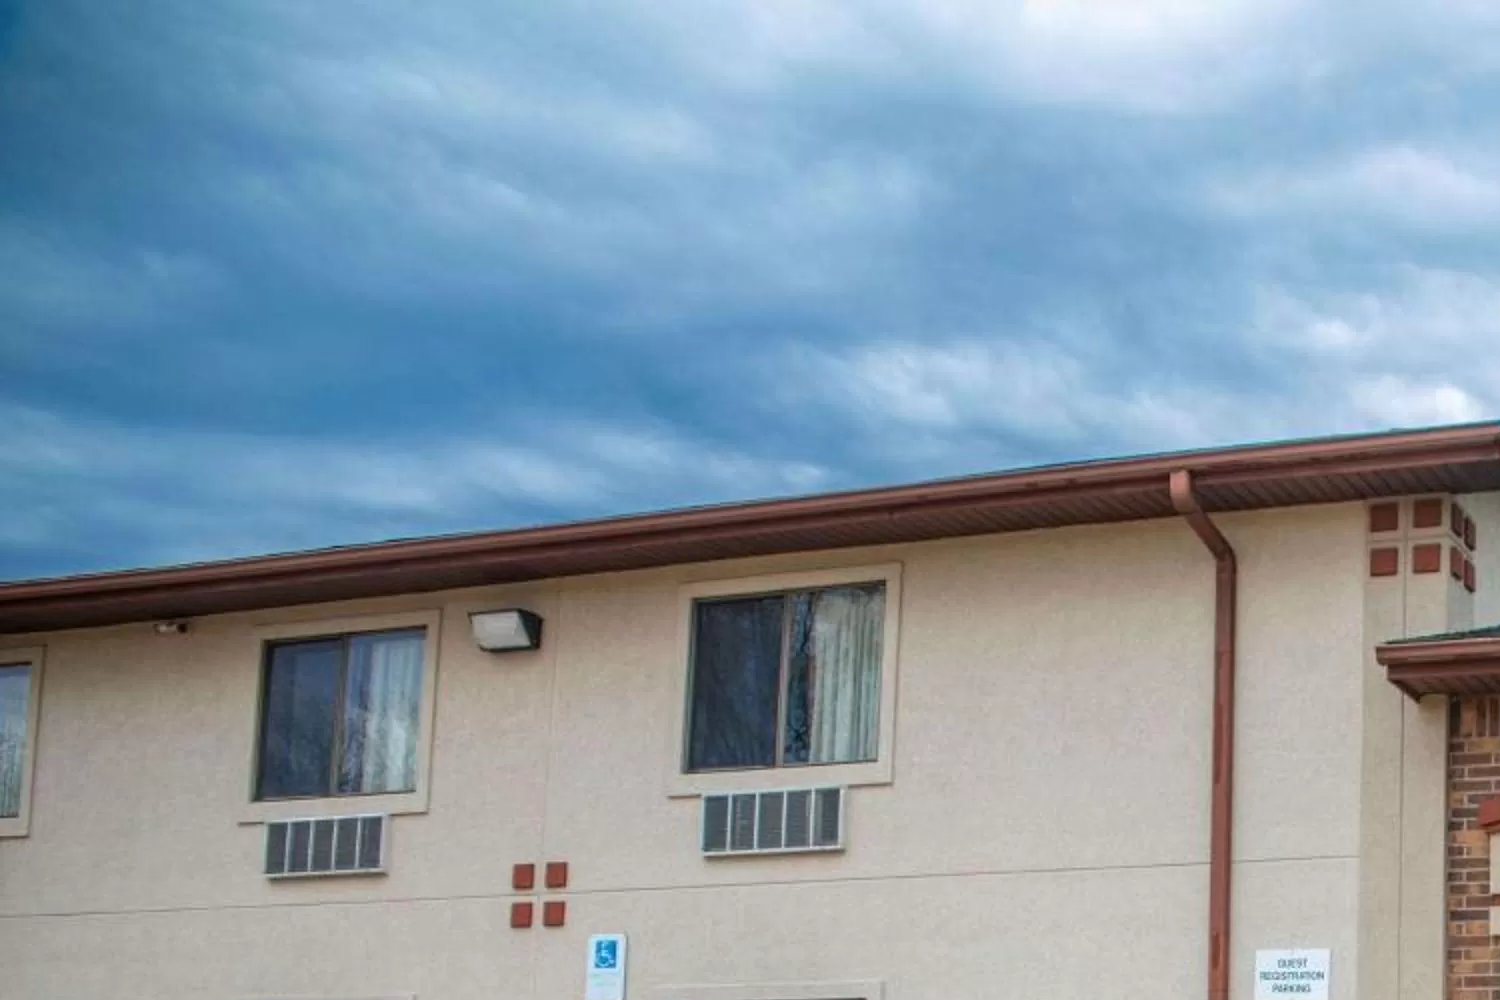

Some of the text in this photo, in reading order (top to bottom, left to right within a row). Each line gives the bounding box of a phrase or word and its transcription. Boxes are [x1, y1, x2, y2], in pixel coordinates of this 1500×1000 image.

[1277, 957, 1308, 968] GUEST
[1259, 970, 1325, 981] REGISTRATION
[1271, 983, 1311, 993] PARKING
